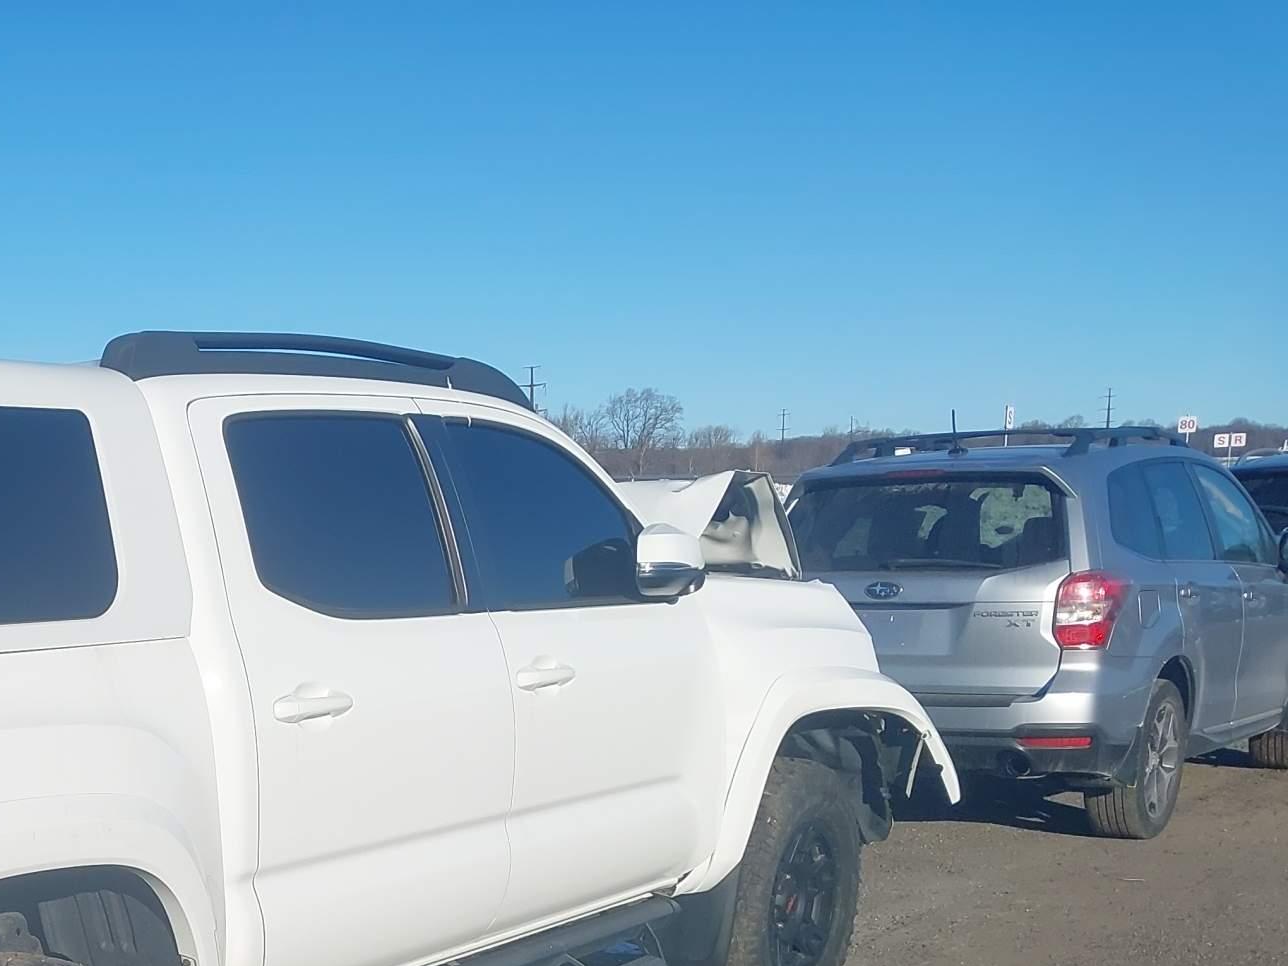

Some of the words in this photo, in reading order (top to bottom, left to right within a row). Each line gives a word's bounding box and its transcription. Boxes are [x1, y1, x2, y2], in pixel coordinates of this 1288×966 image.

[1180, 419, 1195, 430] 80
[1217, 436, 1226, 446] S
[1234, 435, 1242, 445] R
[1005, 619, 1036, 628] XT
